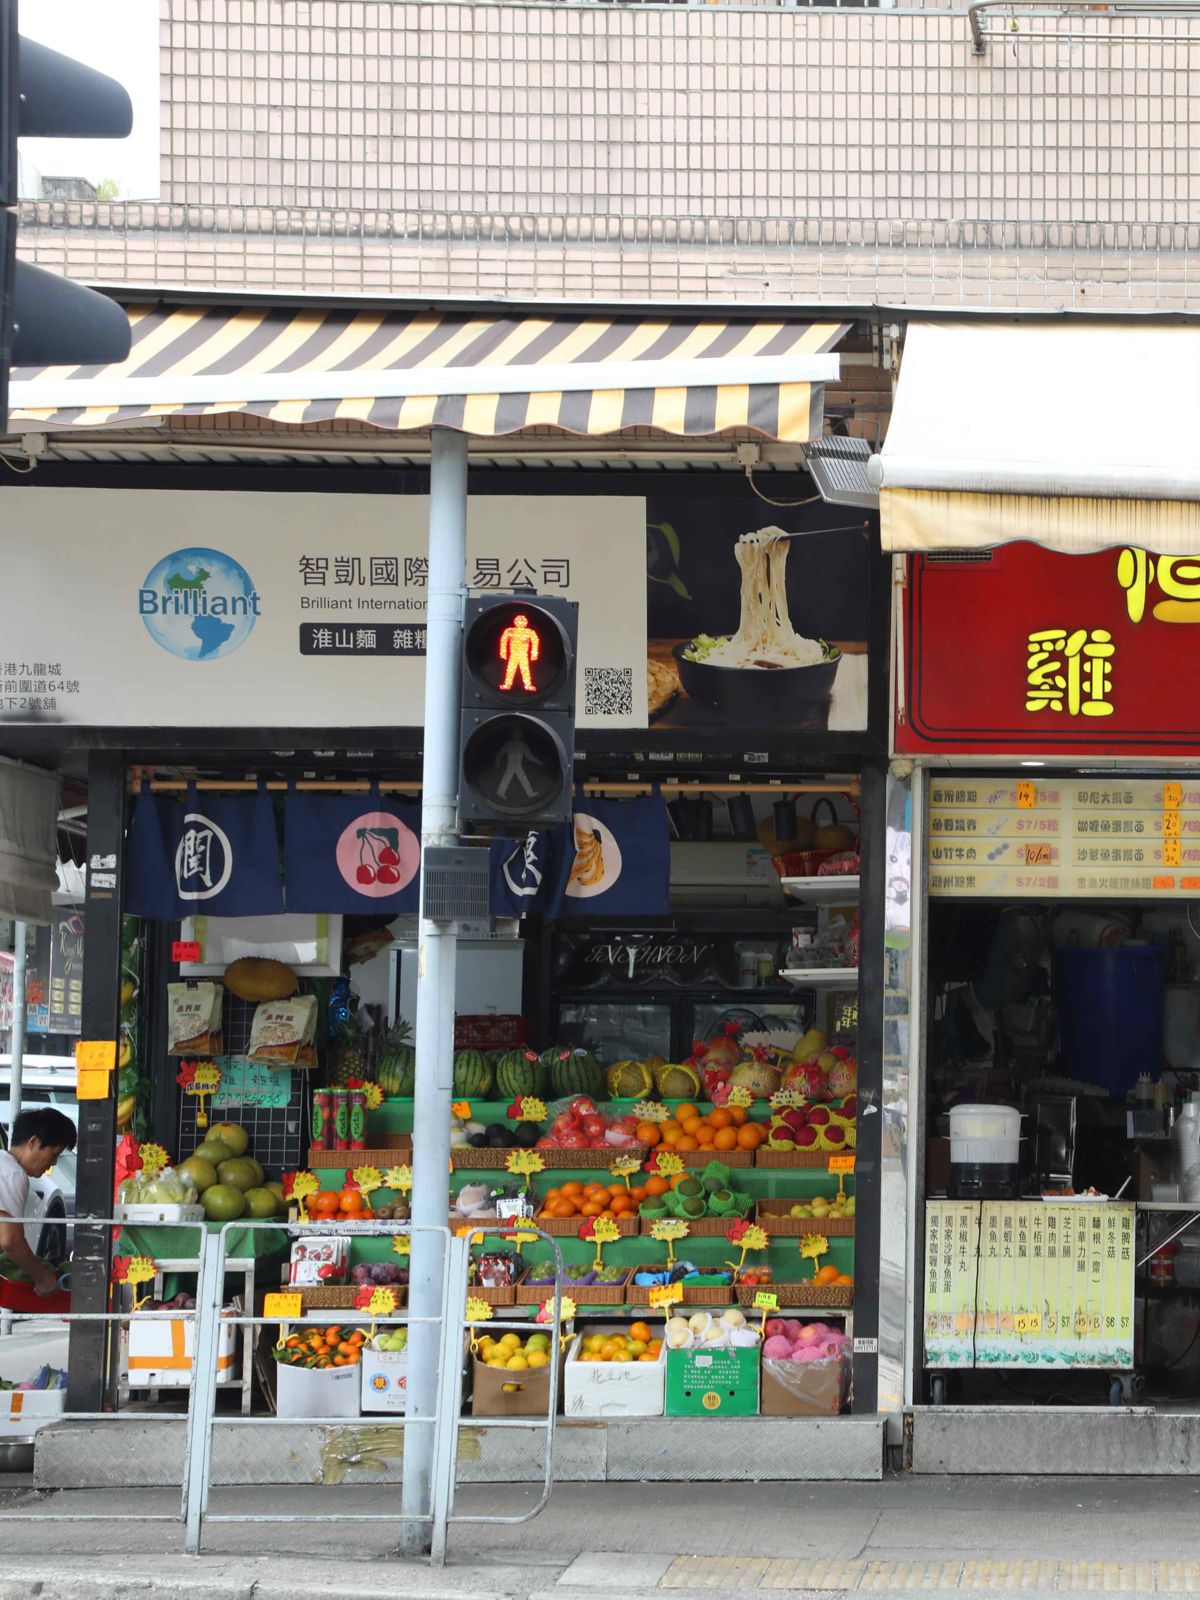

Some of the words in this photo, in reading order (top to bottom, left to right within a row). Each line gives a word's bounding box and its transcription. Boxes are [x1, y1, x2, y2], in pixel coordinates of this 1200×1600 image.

[298, 553, 572, 587] 智凱國際易公司
[138, 588, 261, 616] Brilliant
[301, 596, 353, 610] Brilliant
[357, 596, 428, 610] Internation
[312, 628, 377, 650] 淮山麵
[958, 1215, 968, 1272] 黑椒牛丸
[988, 1215, 998, 1258] 墨魚丸
[1062, 1216, 1072, 1258] 芝士腸
